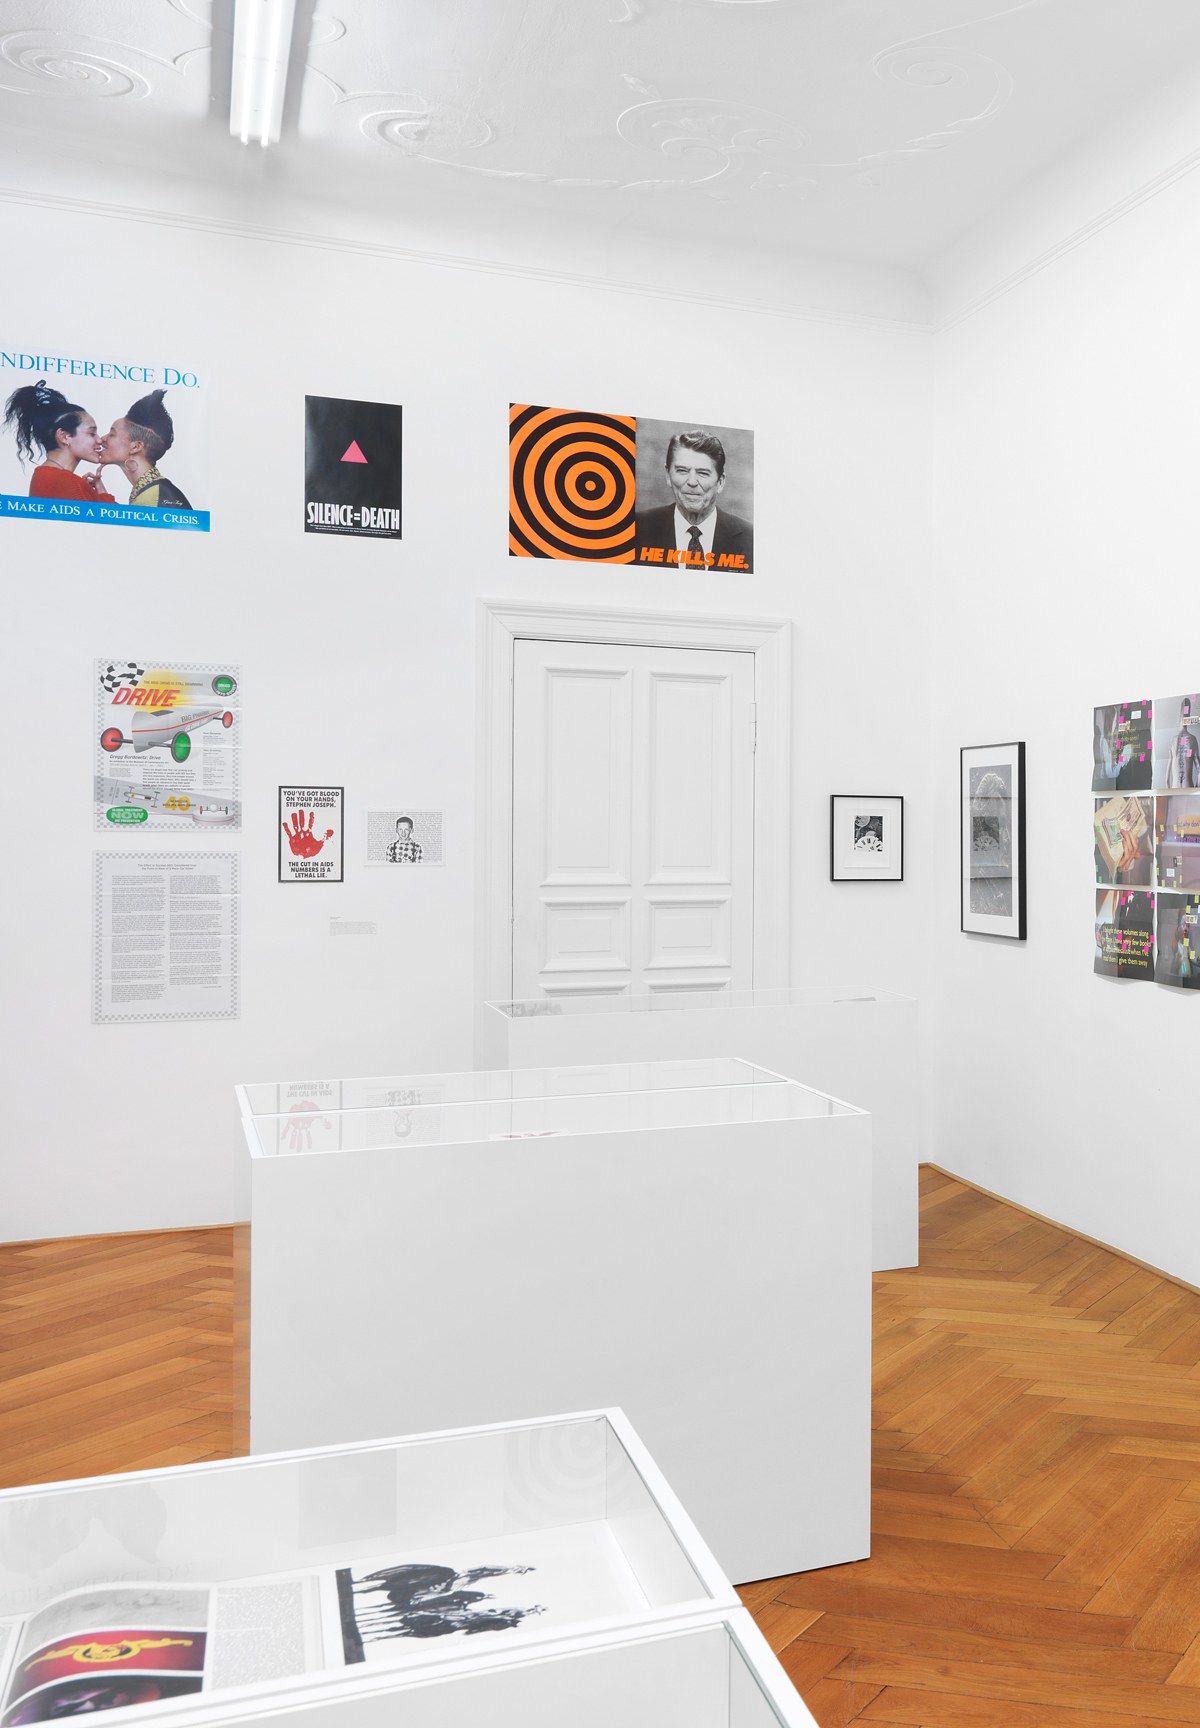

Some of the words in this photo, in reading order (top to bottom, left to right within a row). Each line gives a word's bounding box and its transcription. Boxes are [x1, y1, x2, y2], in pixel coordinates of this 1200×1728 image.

[7, 500, 45, 513] MAKE
[50, 504, 81, 516] AIDS
[86, 508, 95, 517] A
[100, 508, 158, 522] POLITICAL
[163, 513, 200, 525] CRISIS.
[306, 501, 400, 530] SILENCE=DEATH
[640, 546, 665, 562] HE
[666, 549, 716, 567] KILLS
[717, 553, 749, 569] ME.
[111, 687, 181, 706] DRIVE
[164, 795, 191, 811] 40
[111, 811, 145, 819] NOW
